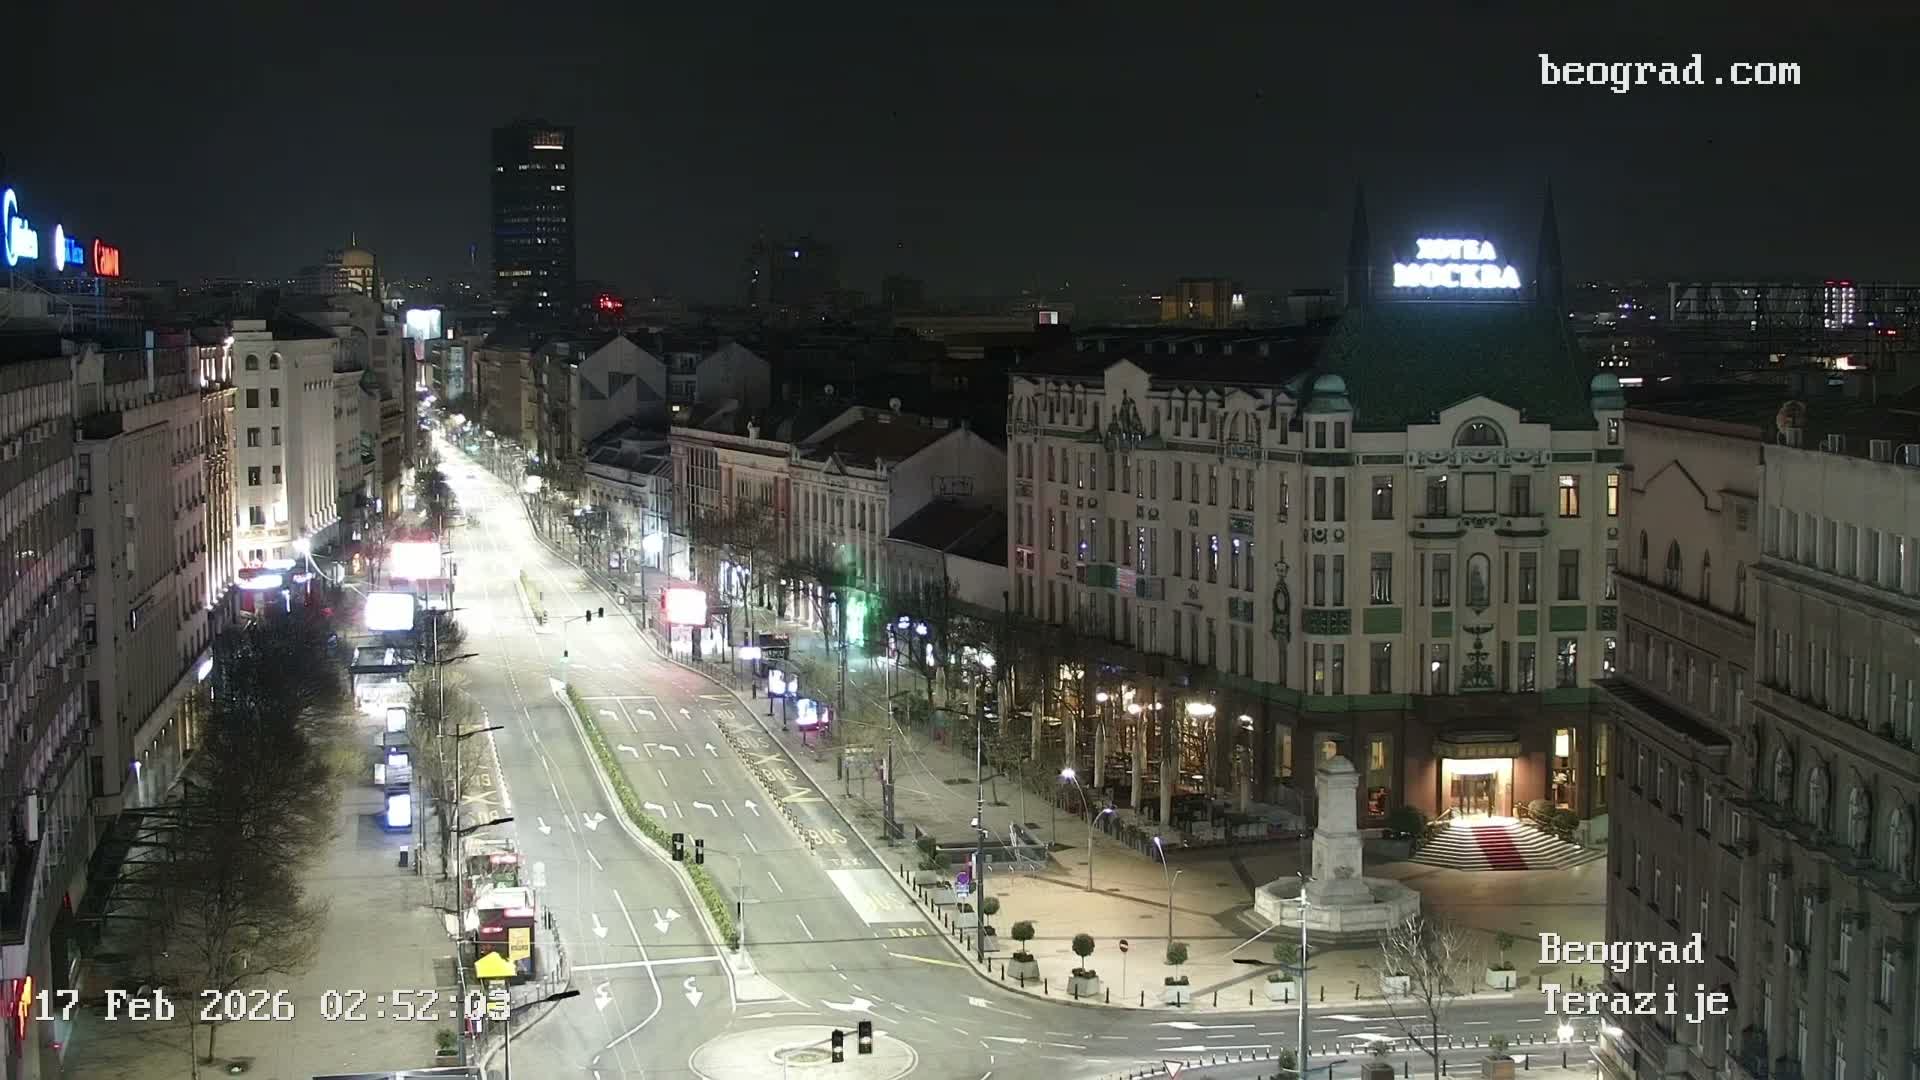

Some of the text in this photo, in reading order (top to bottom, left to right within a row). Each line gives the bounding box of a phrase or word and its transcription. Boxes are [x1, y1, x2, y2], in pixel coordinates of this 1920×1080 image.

[1392, 262, 1522, 289] МОСКВА
[737, 736, 770, 748] BUS
[762, 768, 797, 781] BUS
[808, 828, 848, 845] BUS
[888, 927, 928, 937] TAXI
